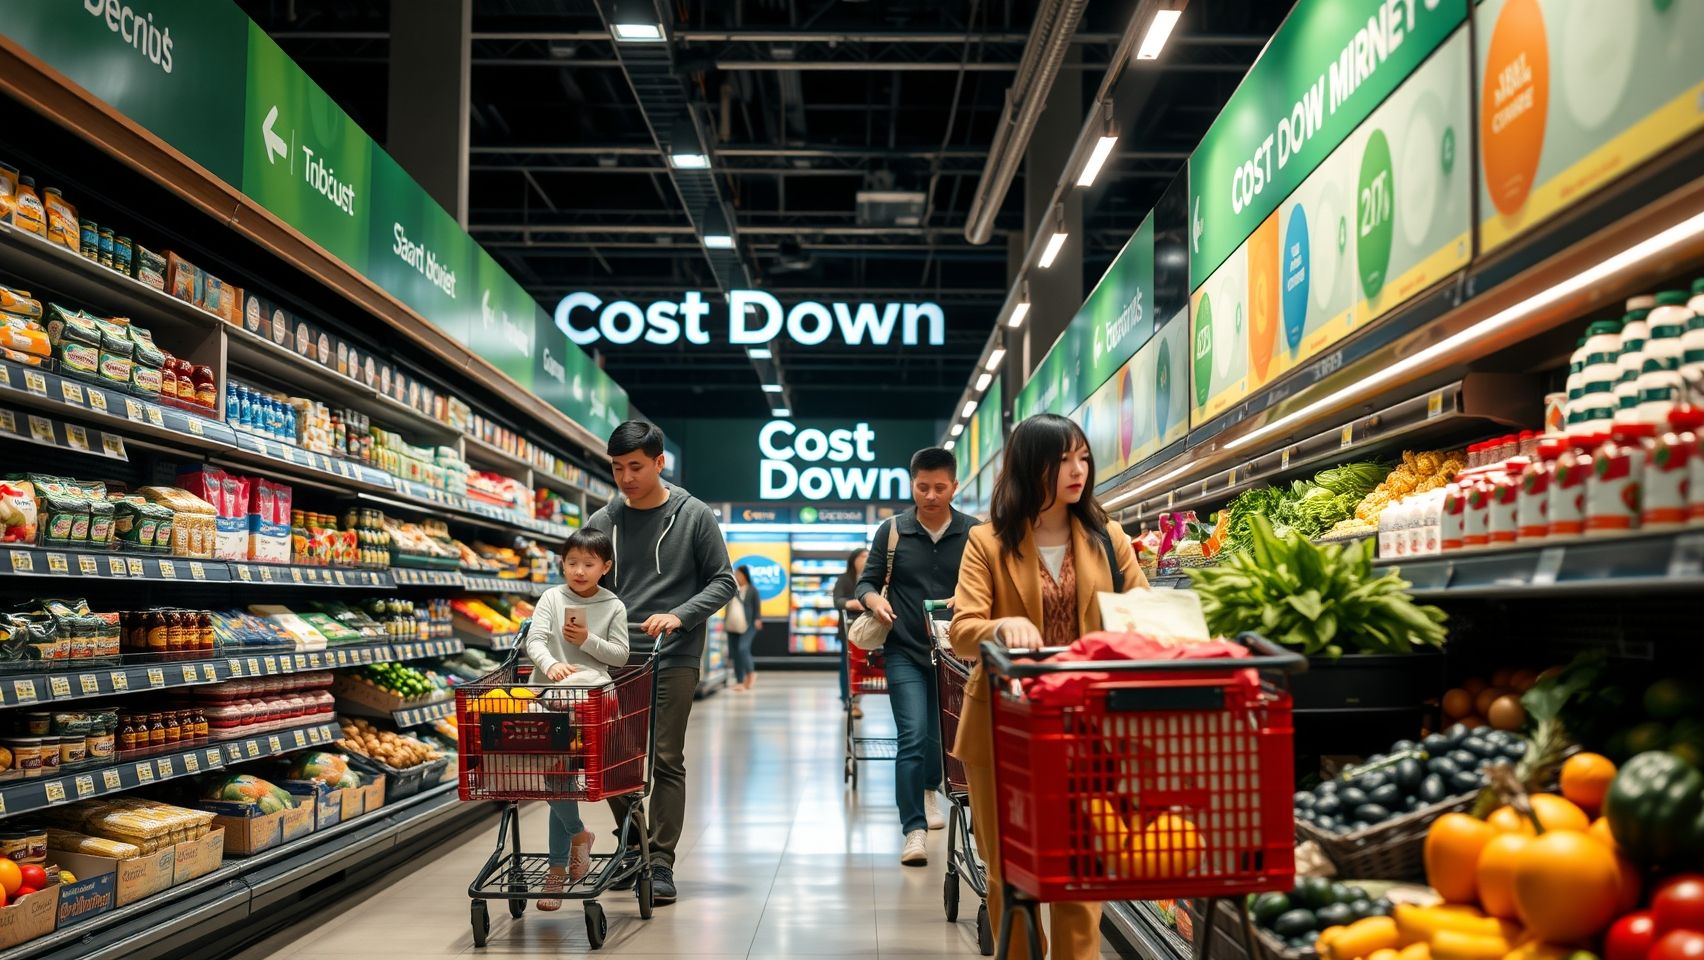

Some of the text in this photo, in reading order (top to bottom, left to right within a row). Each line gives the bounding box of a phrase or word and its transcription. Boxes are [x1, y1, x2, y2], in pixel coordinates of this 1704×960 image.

[1232, 133, 1274, 215] COST
[1278, 74, 1325, 170] DOW
[554, 291, 711, 345] Cost
[729, 290, 945, 346] Down
[758, 420, 875, 462] Cost
[760, 459, 911, 500] Down
